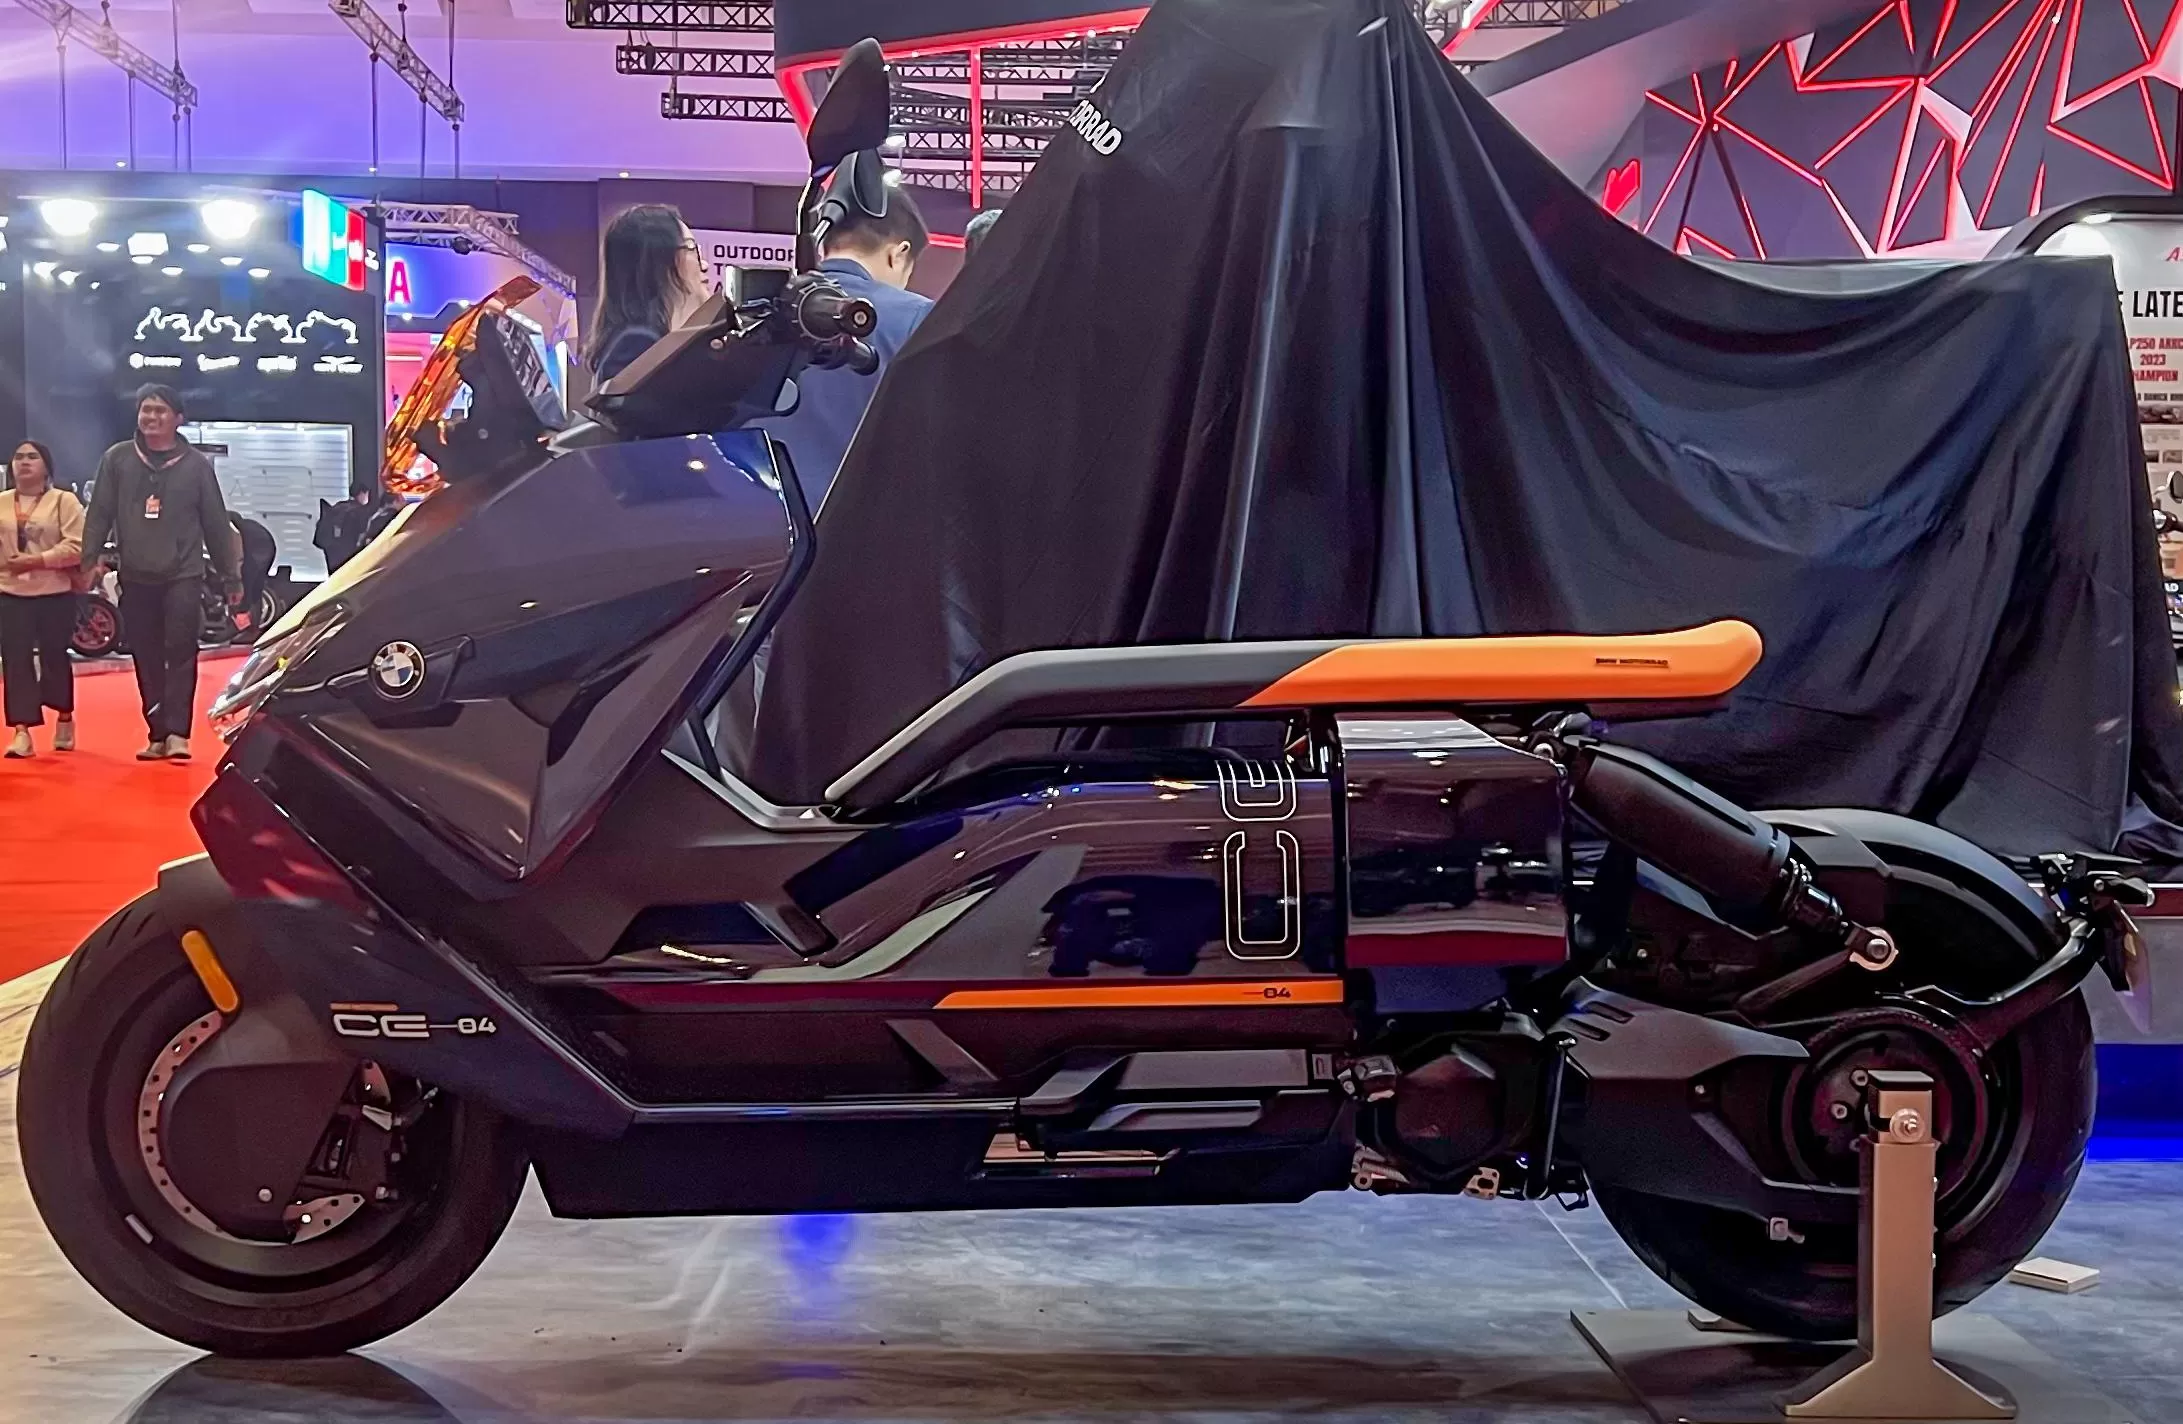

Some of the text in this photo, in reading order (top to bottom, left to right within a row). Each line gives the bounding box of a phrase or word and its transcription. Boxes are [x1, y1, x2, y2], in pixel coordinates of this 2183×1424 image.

[1069, 100, 1122, 155] ORRAD
[2129, 338, 2155, 349] P250
[2140, 354, 2166, 365] 2023
[2133, 371, 2178, 381] HAMPION
